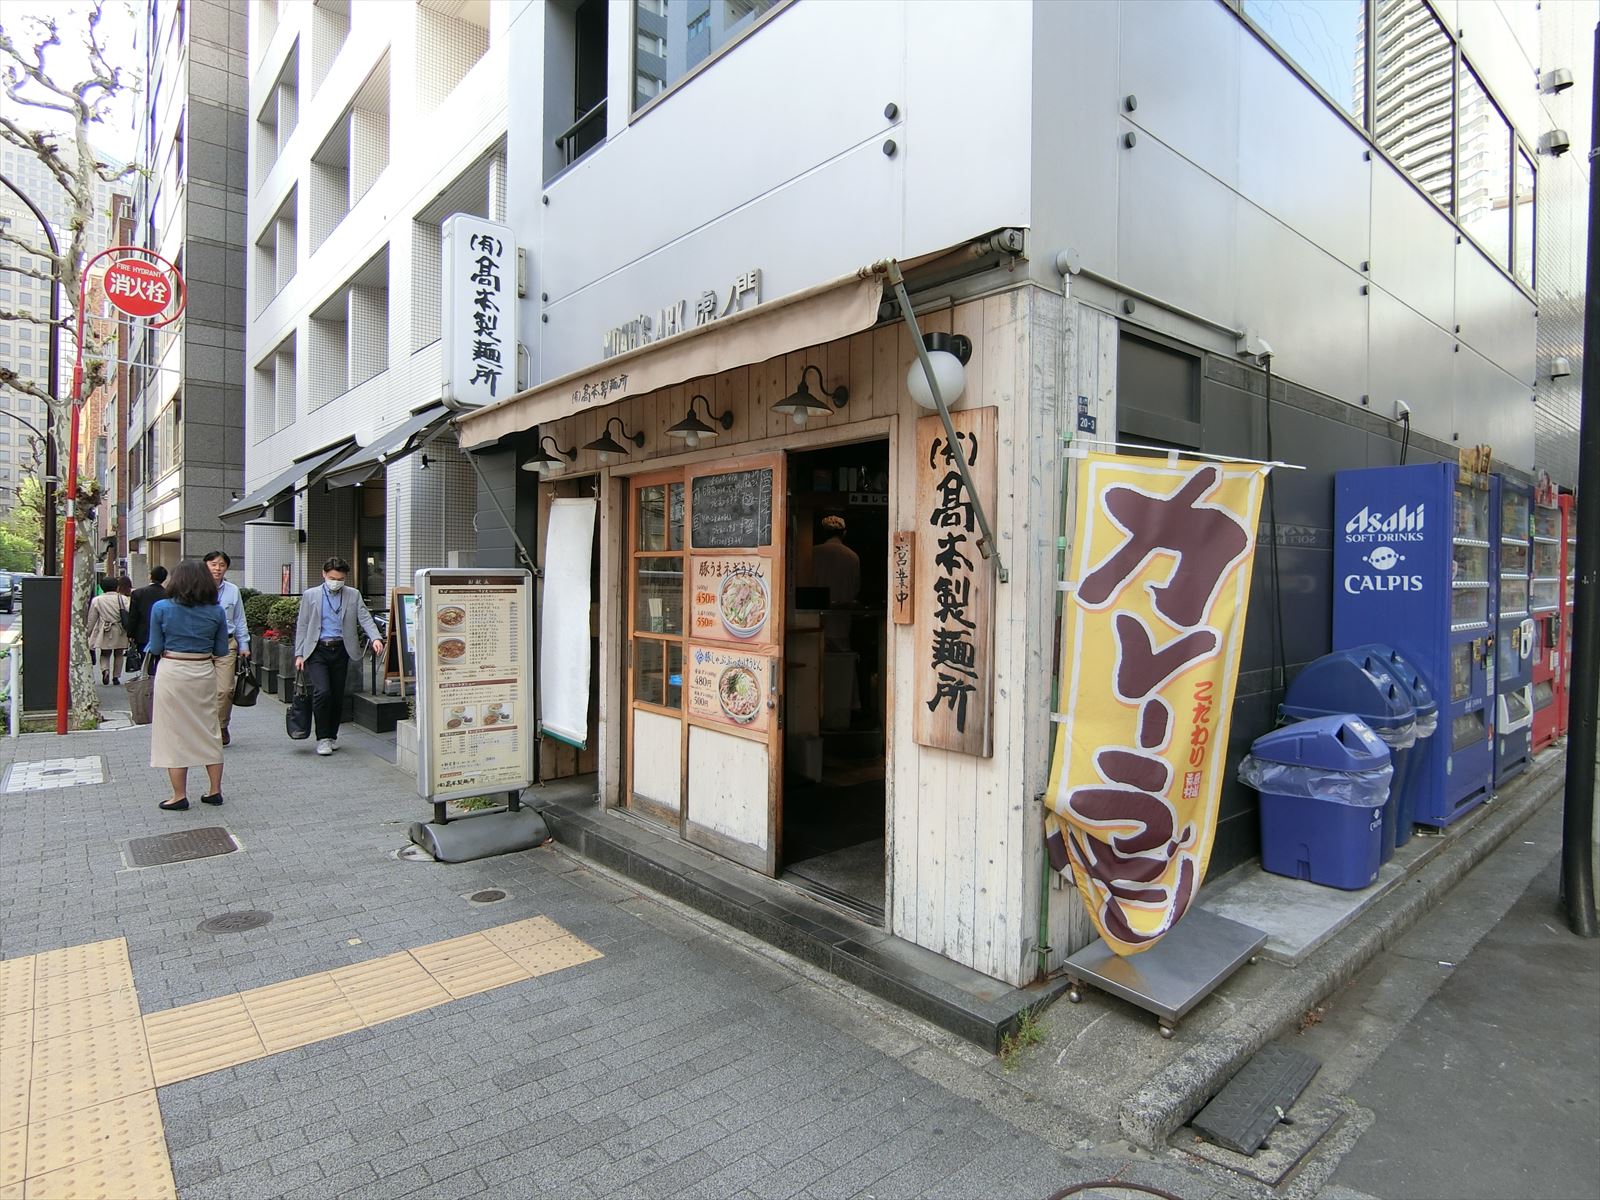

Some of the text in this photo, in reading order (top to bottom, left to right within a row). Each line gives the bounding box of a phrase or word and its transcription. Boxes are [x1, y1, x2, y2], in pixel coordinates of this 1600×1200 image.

[116, 263, 162, 278] FIRE HYDRANT
[109, 271, 168, 304] 消火栓
[695, 268, 762, 327] 虎ノ門
[1079, 417, 1095, 430] 20-3
[1345, 503, 1425, 534] Asahi
[1345, 531, 1424, 543] SOFT DRINKS
[894, 544, 909, 613] 営業中
[1344, 574, 1423, 595] CALPIS
[696, 592, 716, 605] 450円
[696, 617, 714, 628] 550円
[694, 675, 712, 688] 480円
[1189, 680, 1214, 768] こだわり
